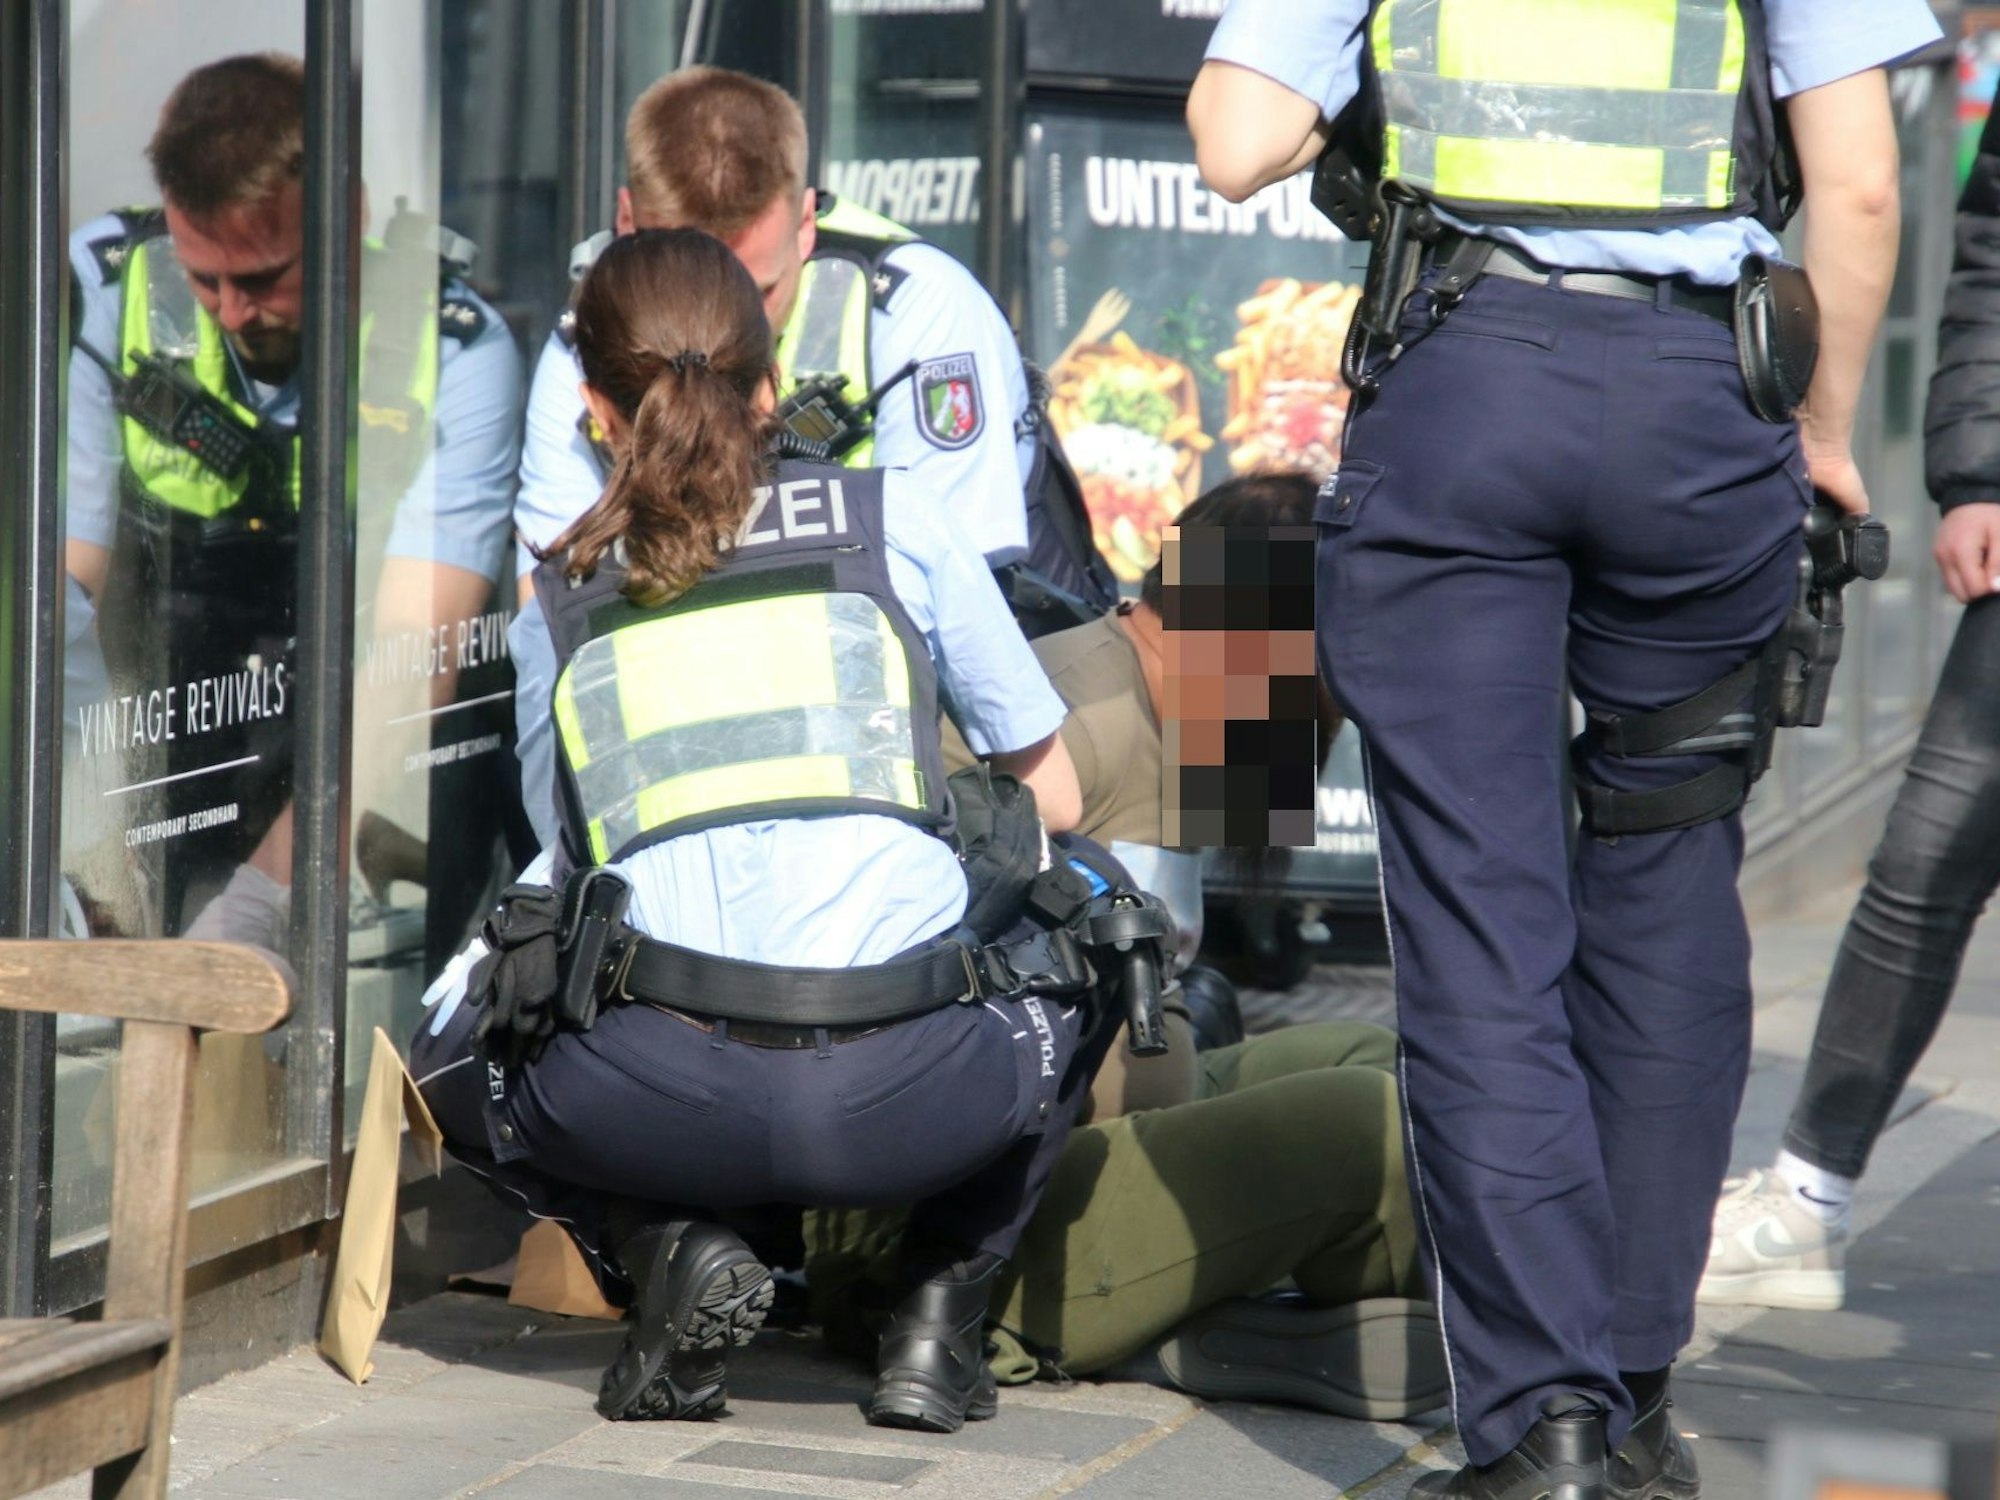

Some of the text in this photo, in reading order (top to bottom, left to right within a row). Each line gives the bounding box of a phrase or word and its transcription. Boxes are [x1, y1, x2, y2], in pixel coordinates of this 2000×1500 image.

[366, 624, 448, 688] VINTAGE
[79, 663, 285, 758] VINTAGE REVIVALS
[125, 803, 239, 848] CONTEMPORARY SECONDHAND
